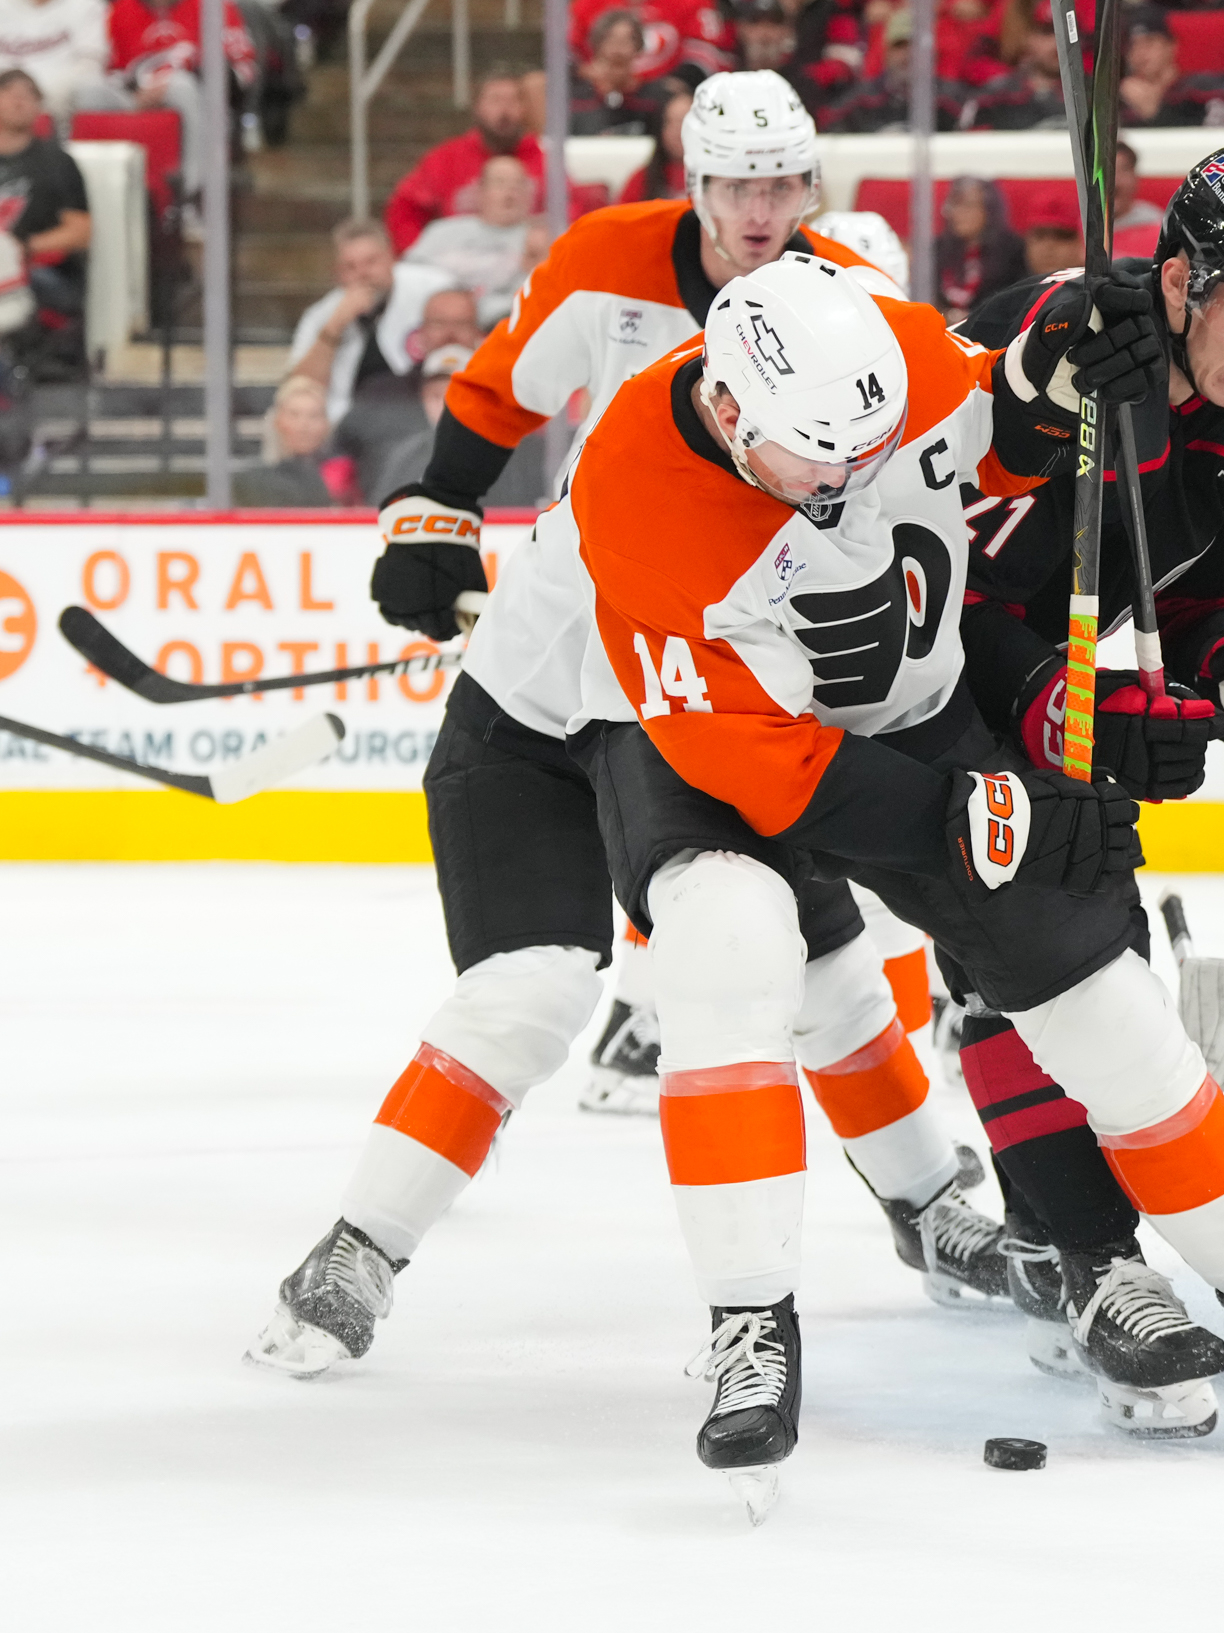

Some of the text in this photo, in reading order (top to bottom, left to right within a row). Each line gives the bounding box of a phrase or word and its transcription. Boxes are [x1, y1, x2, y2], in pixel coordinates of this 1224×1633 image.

[753, 109, 768, 127] 5
[1044, 321, 1069, 333] CCM
[735, 323, 778, 391] CHEVROLET
[856, 372, 886, 411] 14
[851, 425, 894, 452] CCM
[1034, 424, 1070, 439] CCM
[919, 437, 956, 490] C
[392, 515, 481, 544] CCM
[82, 549, 335, 611] ORAL
[153, 640, 446, 703] ORTHO
[633, 631, 714, 721] 14
[1042, 672, 1069, 767] CC
[190, 729, 285, 763] ORA
[957, 836, 974, 882] COUTURIER
